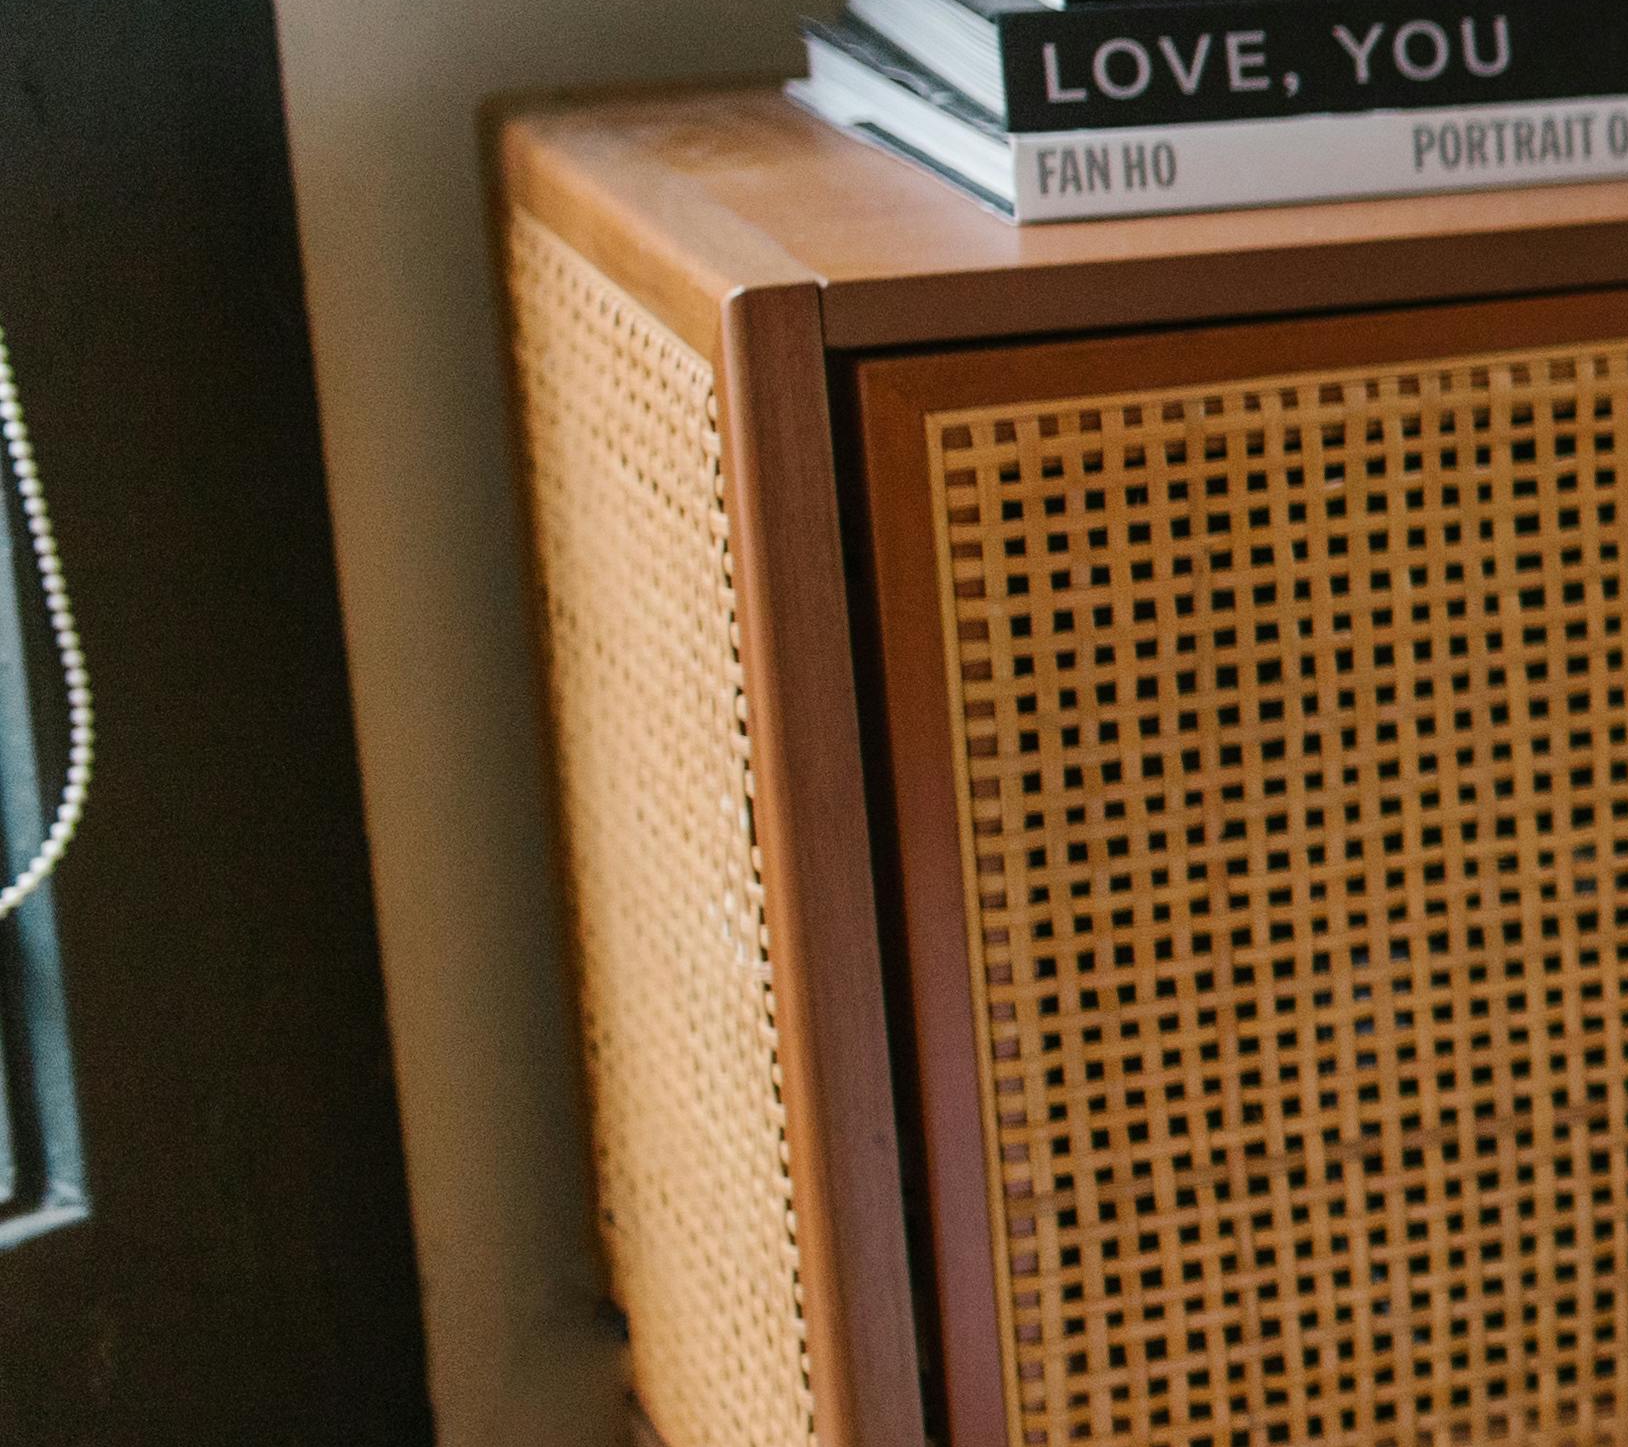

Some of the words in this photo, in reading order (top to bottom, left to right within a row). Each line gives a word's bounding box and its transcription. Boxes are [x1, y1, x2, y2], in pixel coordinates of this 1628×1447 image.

[1042, 30, 1300, 104] LOVE,
[1333, 14, 1511, 85] YOU
[1037, 145, 1112, 195] FAN
[1123, 140, 1178, 191] HO
[1411, 109, 1595, 172] PORTRAIT
